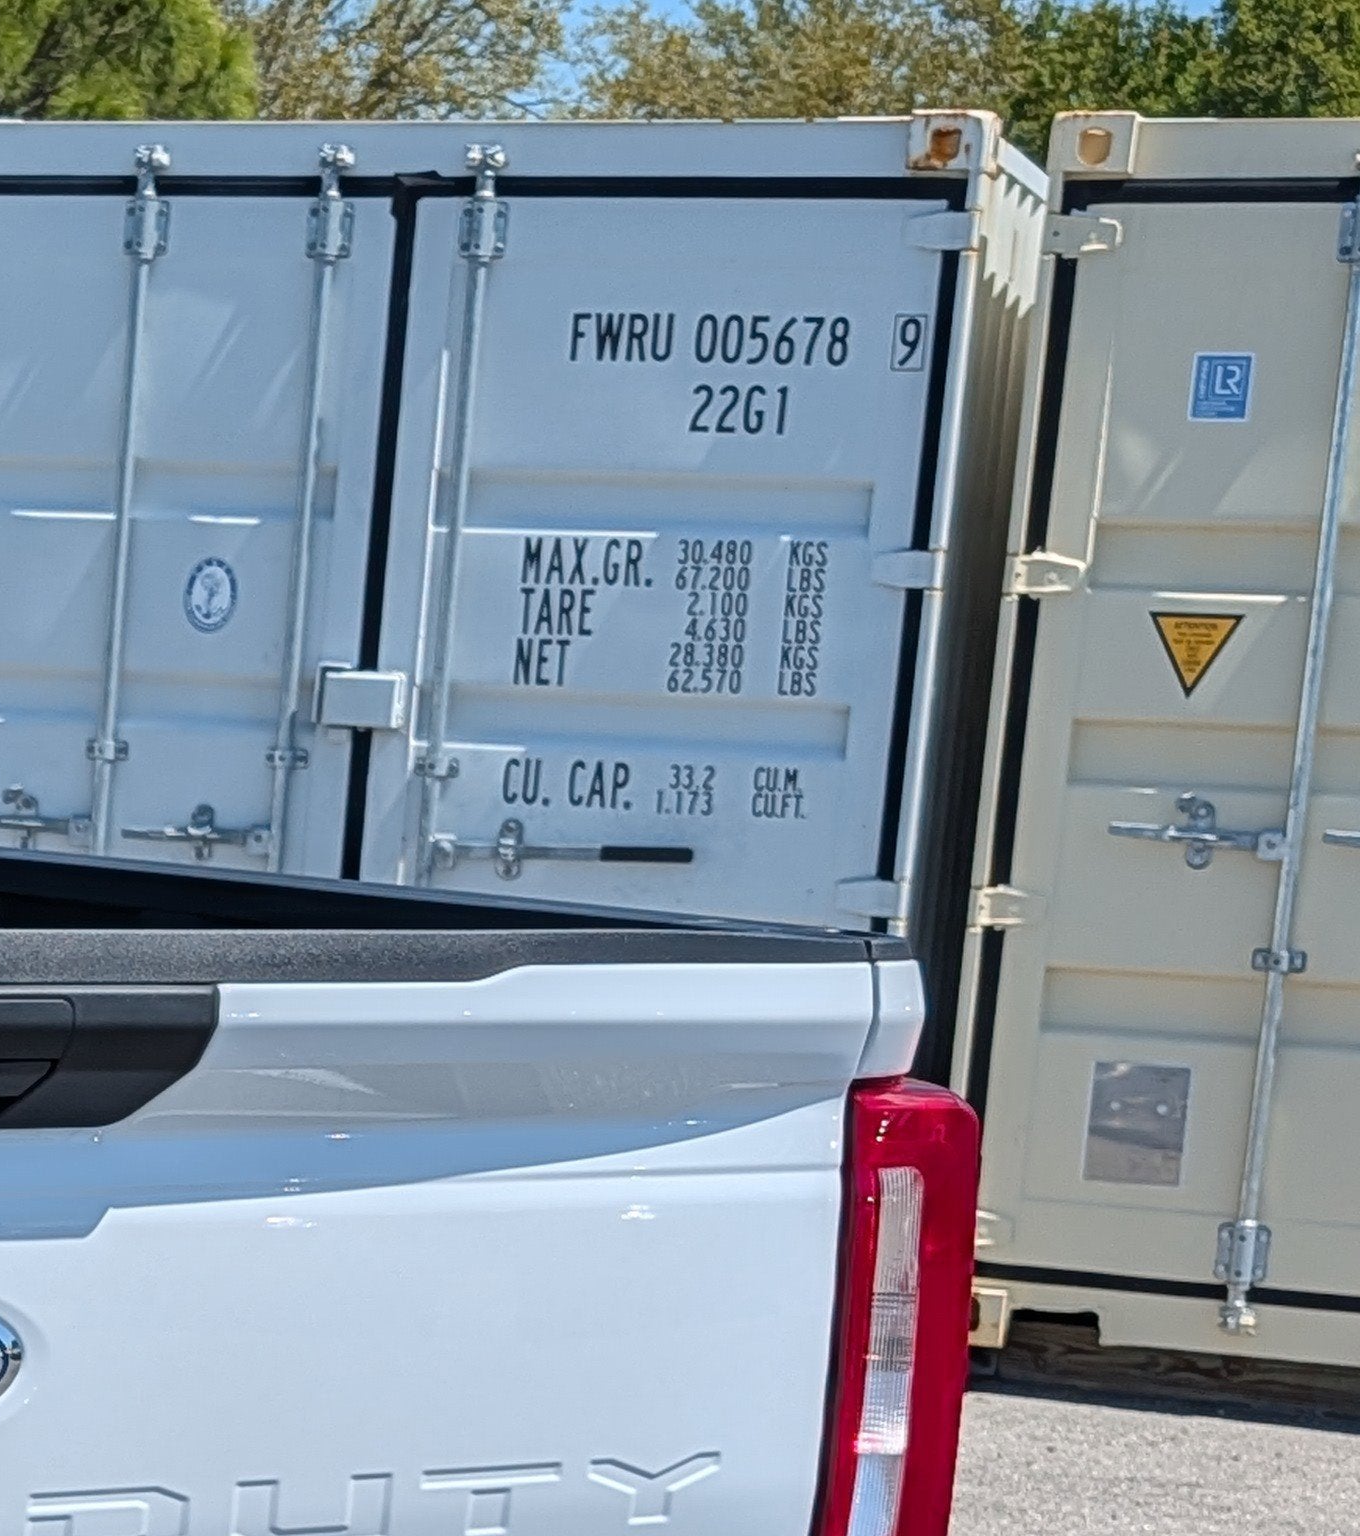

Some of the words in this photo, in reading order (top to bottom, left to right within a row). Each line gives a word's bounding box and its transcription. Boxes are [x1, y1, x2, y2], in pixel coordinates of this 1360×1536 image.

[569, 312, 675, 362] FWRU
[695, 313, 850, 367] 005678
[898, 317, 922, 367] 9
[688, 384, 789, 436] 22G1
[678, 539, 752, 566] 30.480
[788, 540, 829, 568] KGS
[675, 566, 750, 592] 67.200
[786, 567, 826, 593] LBS
[520, 587, 596, 636] TARE
[686, 592, 748, 617] 2.100
[783, 593, 824, 619] KGS
[684, 617, 746, 643] 4.630
[782, 619, 822, 645] LBS
[513, 638, 571, 686] NET
[668, 642, 744, 669] 28.380
[779, 644, 820, 671] KGS
[667, 668, 742, 694] 62.570
[777, 671, 817, 697] LBS
[502, 757, 549, 807] CU.
[568, 760, 632, 810] CAP.
[668, 763, 716, 791] 33.2
[656, 788, 714, 816] 1.173
